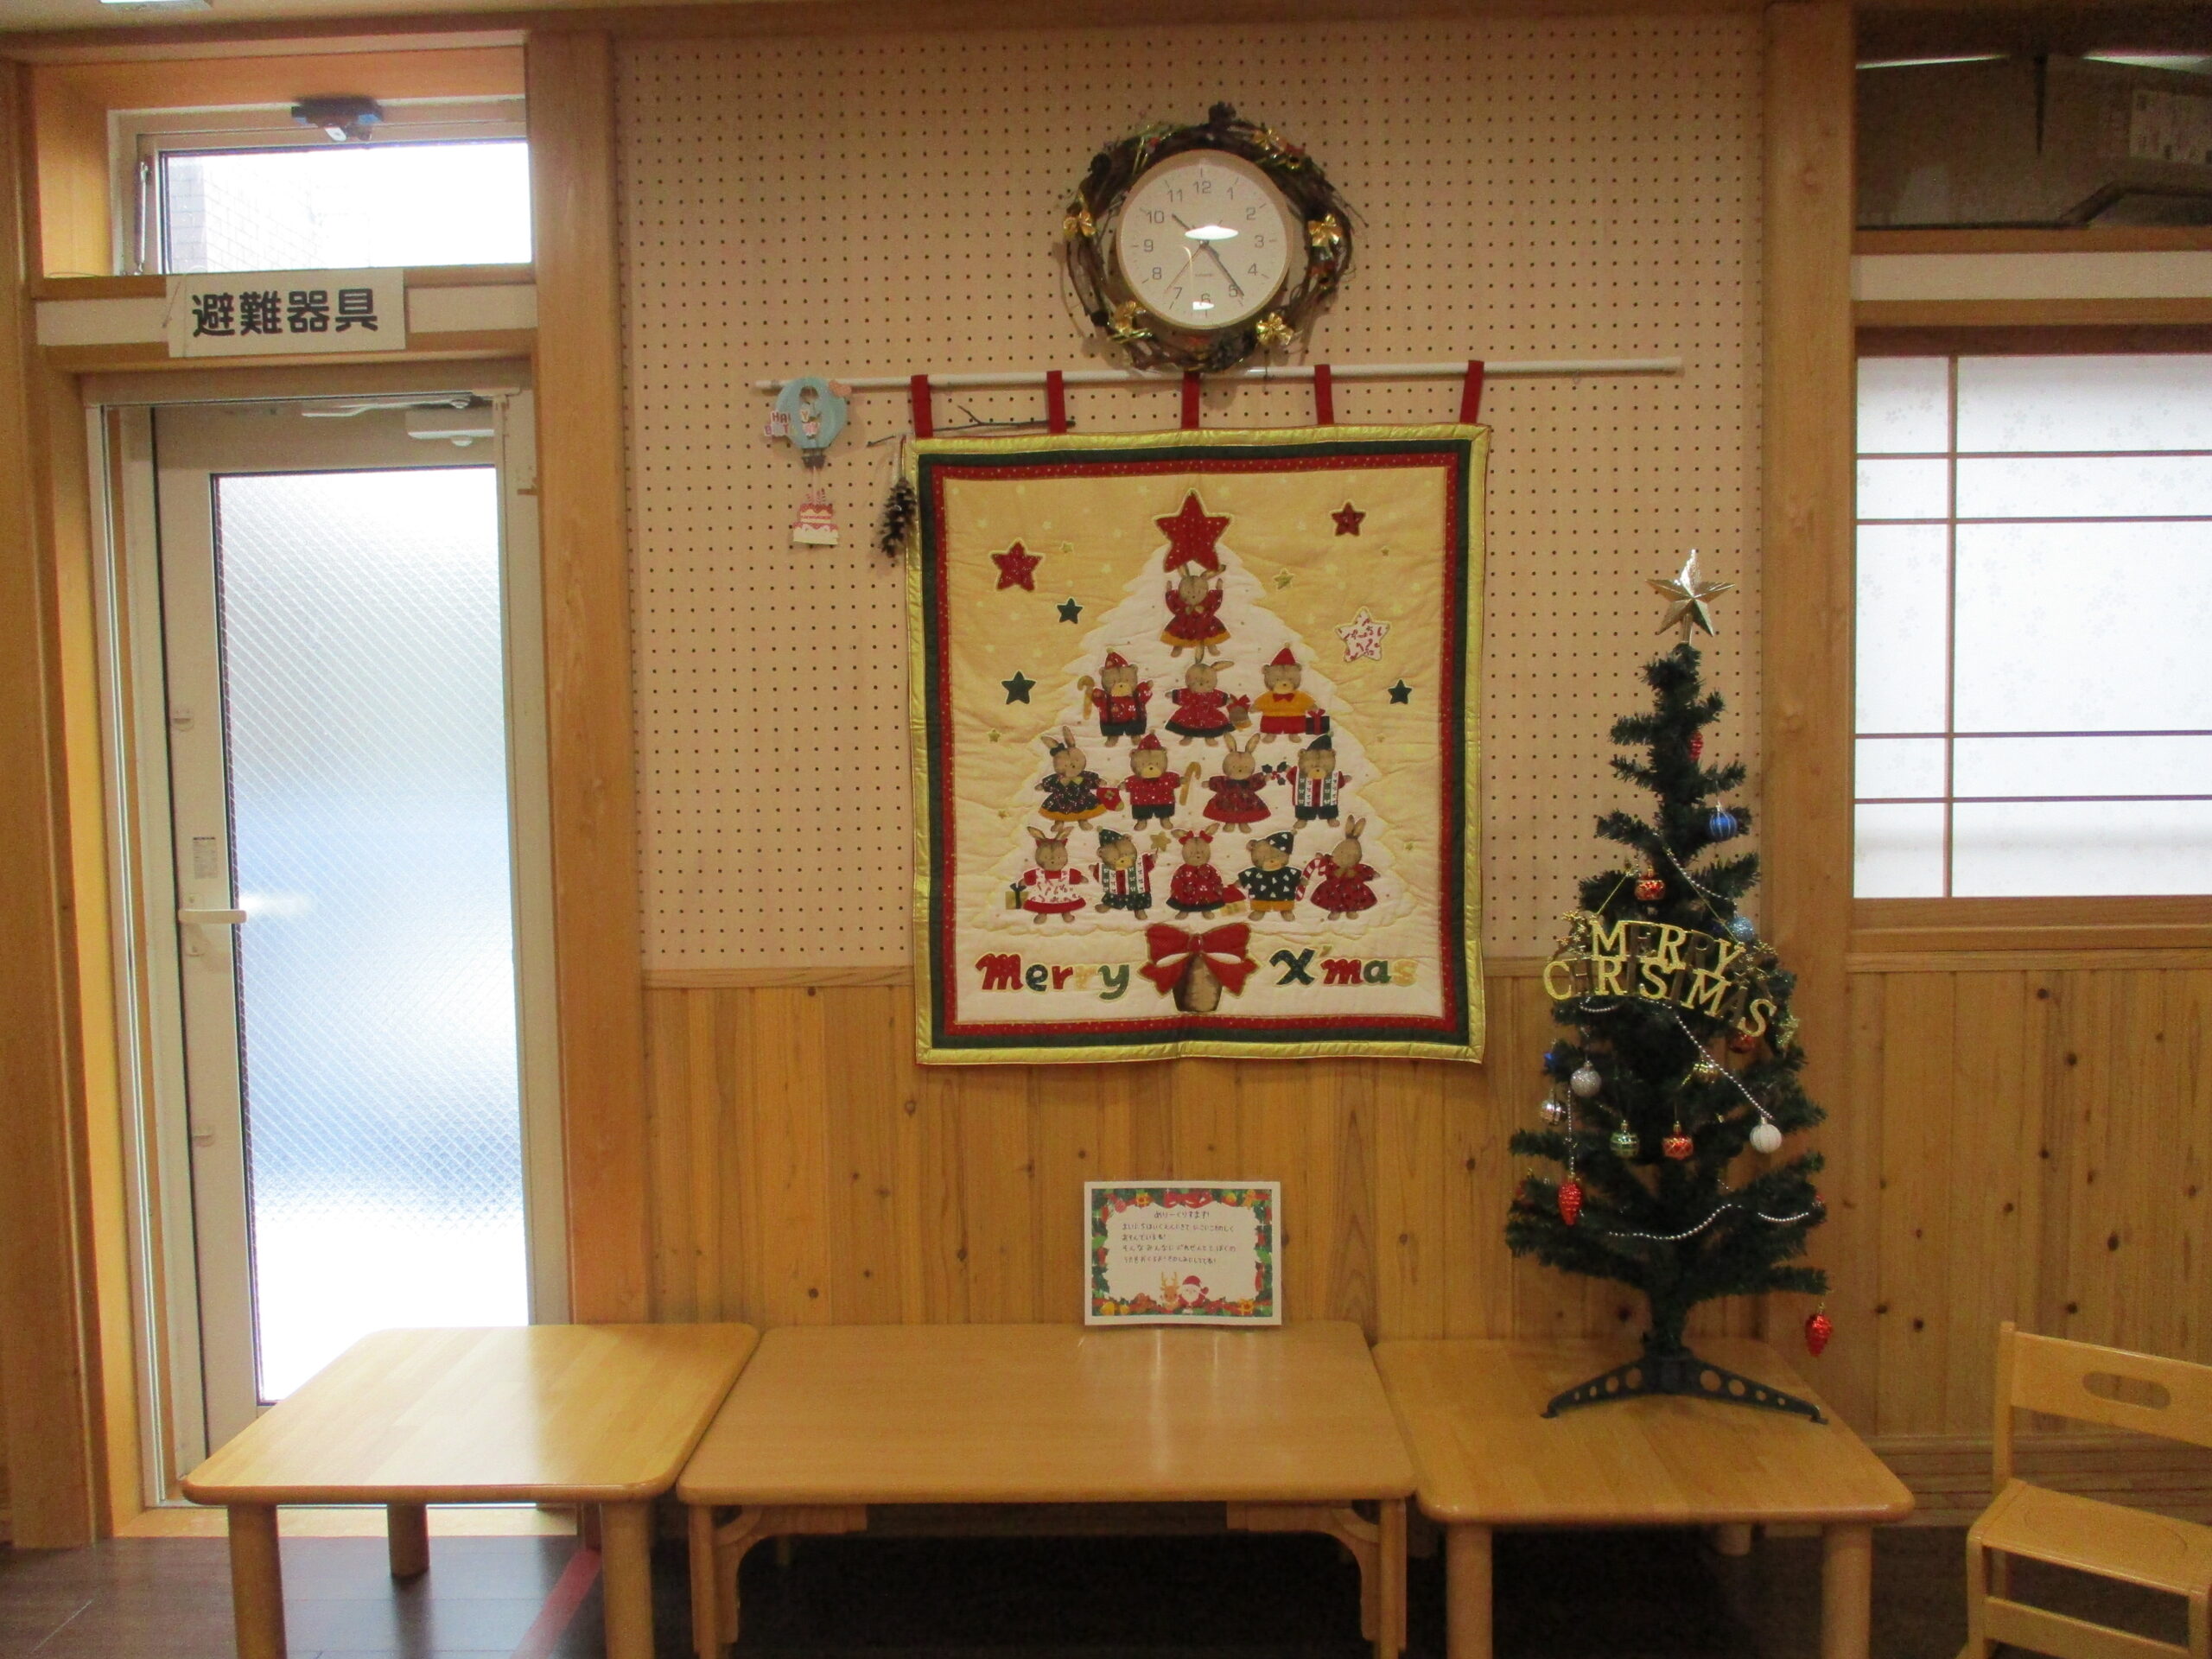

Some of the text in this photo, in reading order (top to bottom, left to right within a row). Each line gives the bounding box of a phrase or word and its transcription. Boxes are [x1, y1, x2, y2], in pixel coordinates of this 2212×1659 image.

[1192, 180, 1212, 194] 12
[1227, 186, 1234, 200] 1
[1167, 189, 1184, 202] 11
[1147, 210, 1165, 224] 10
[1246, 207, 1256, 220] 2
[1143, 239, 1154, 252] 9
[1255, 235, 1264, 248] 3
[1152, 266, 1162, 280] 8
[1248, 264, 1258, 276] 4
[1173, 286, 1183, 300] 7
[1229, 284, 1239, 297] 5
[191, 288, 378, 337] 避難器具
[974, 944, 1420, 1001] Merry X'mas
